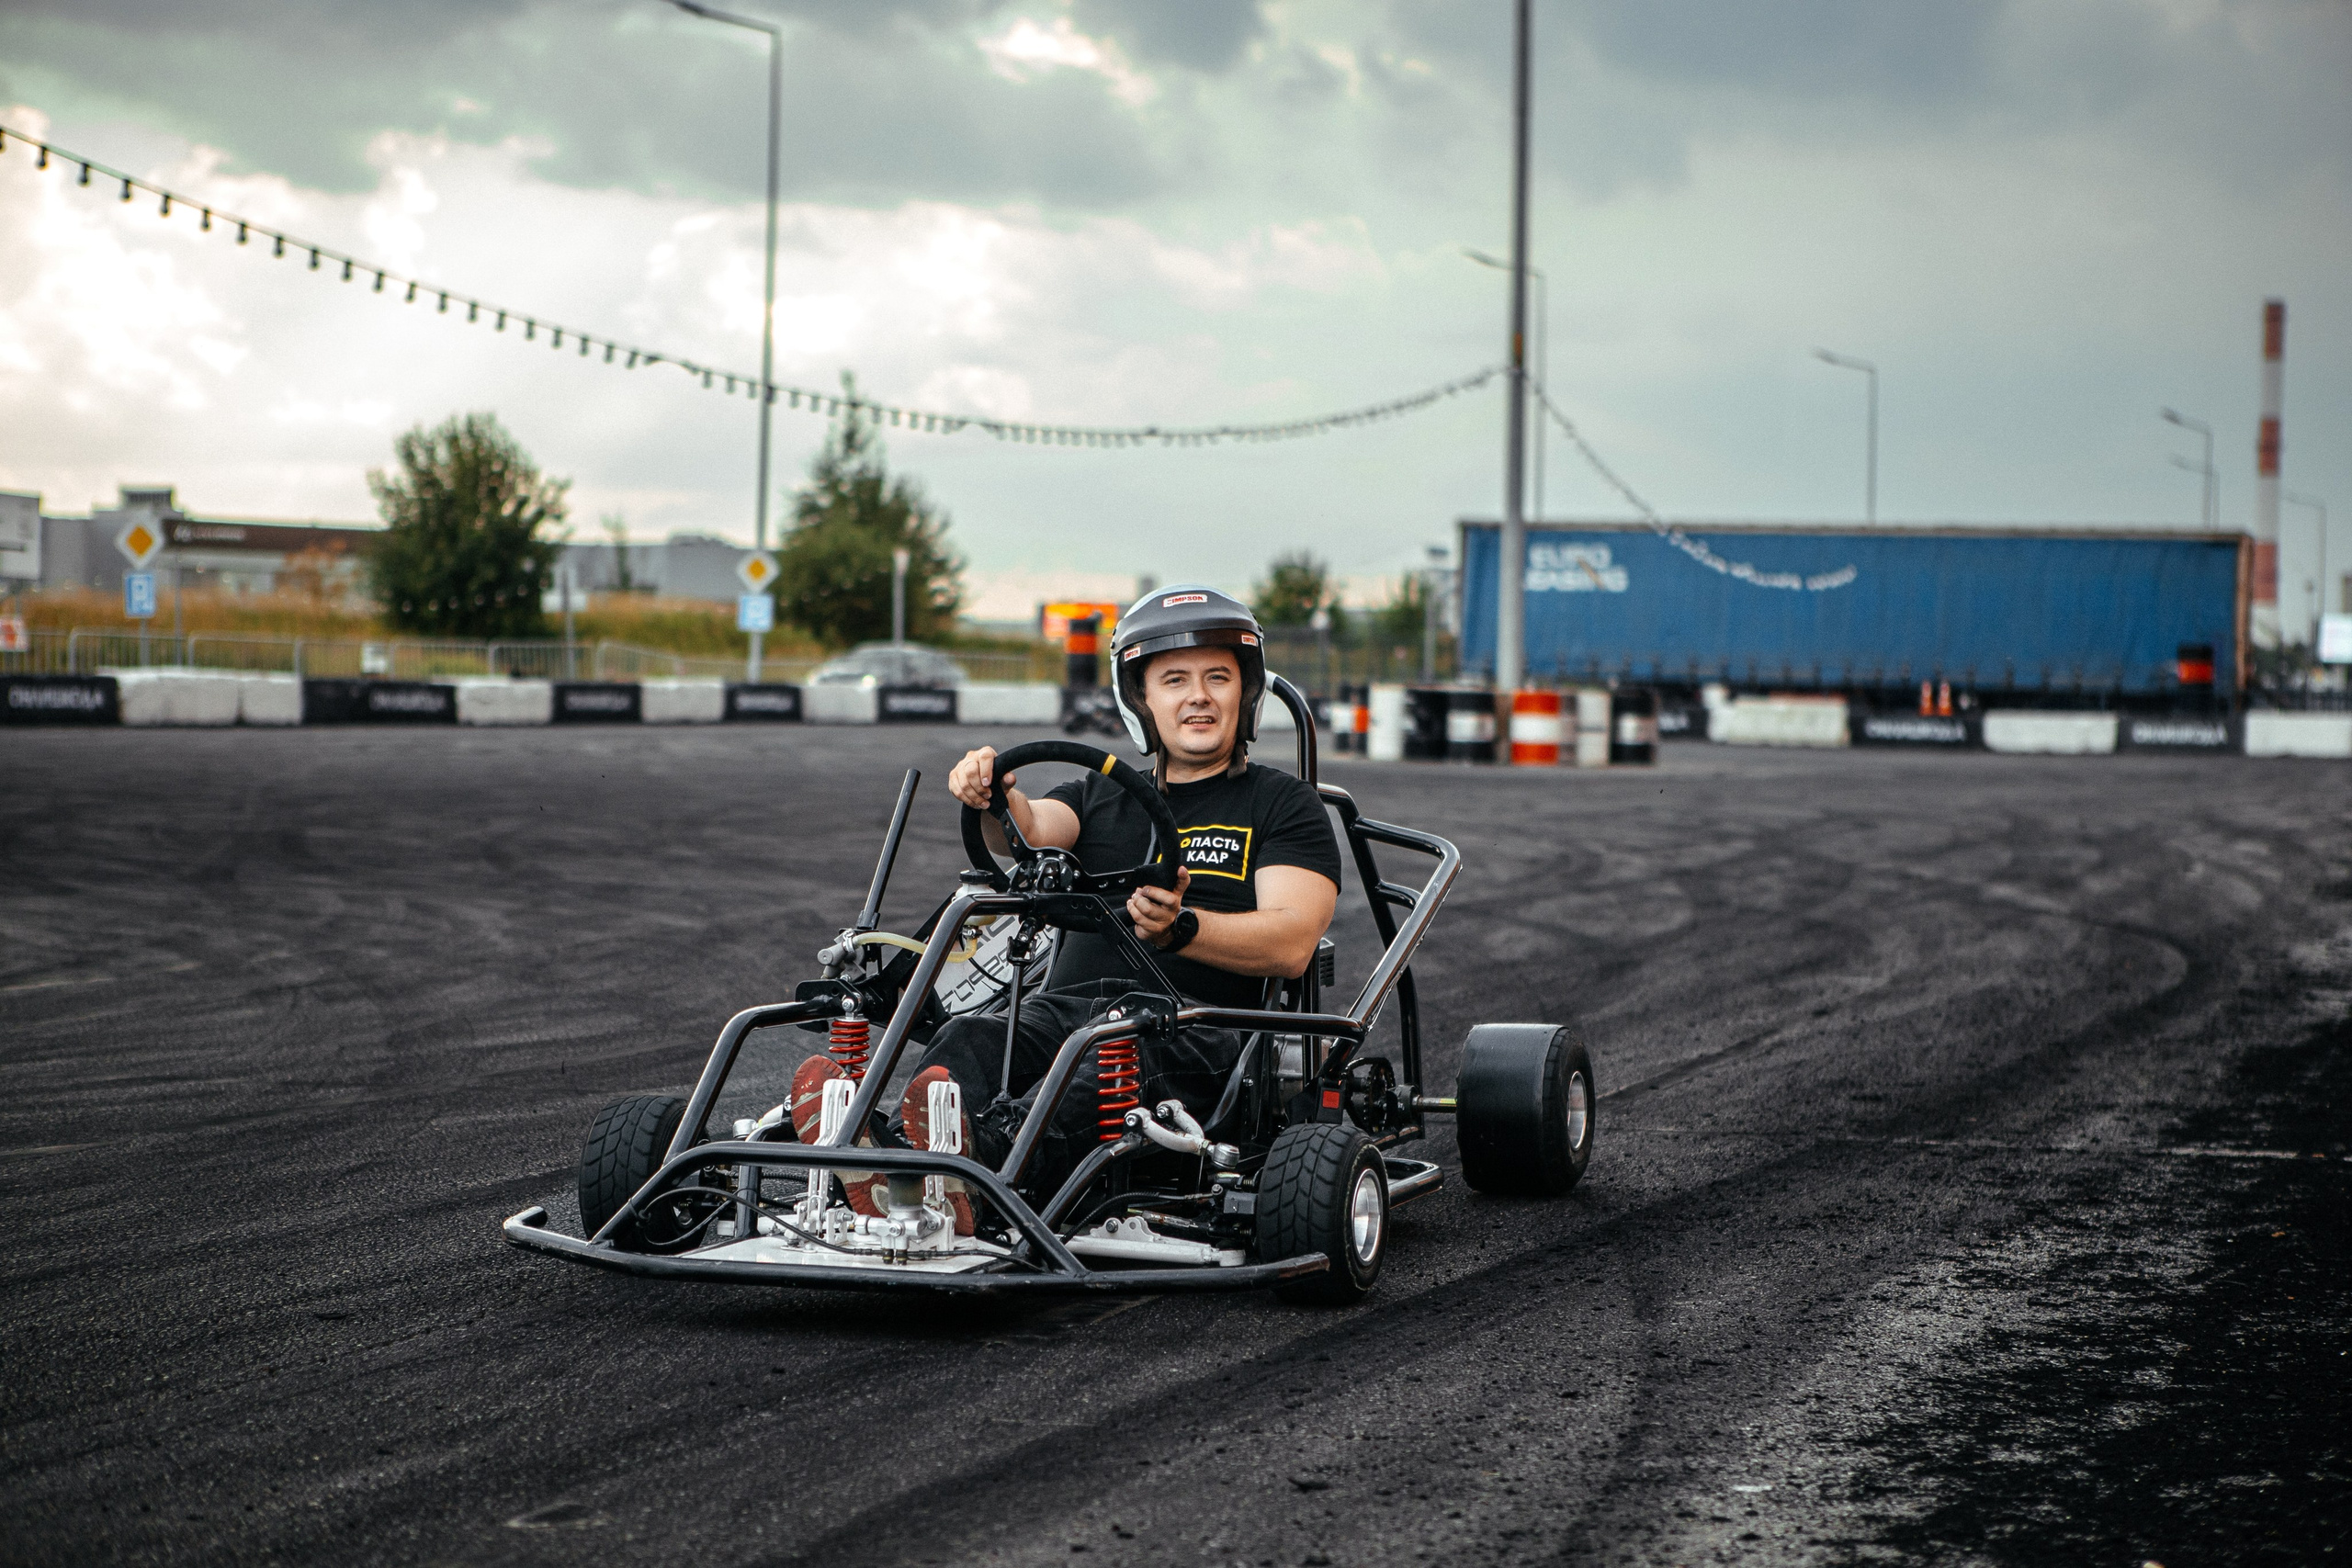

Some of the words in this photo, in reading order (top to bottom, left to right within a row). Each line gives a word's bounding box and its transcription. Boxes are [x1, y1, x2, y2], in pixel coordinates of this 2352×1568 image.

[1167, 595, 1204, 605] SIMPSON
[1180, 837, 1240, 852] ОПАСТЬ
[1186, 850, 1229, 863] КАДР
